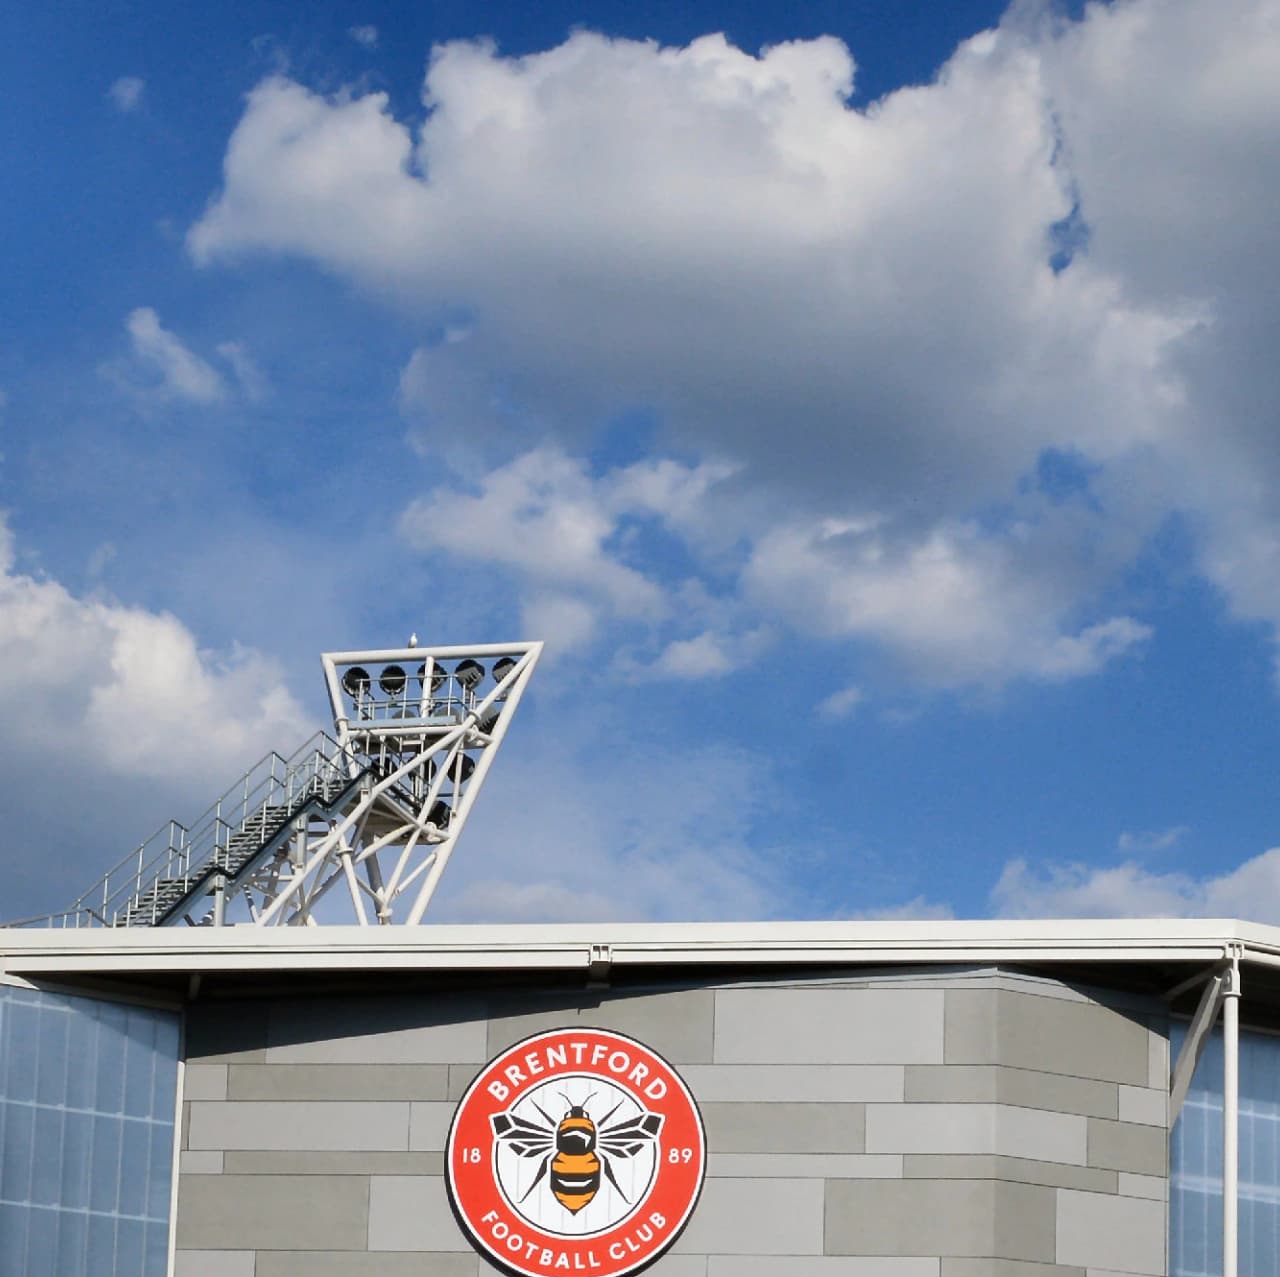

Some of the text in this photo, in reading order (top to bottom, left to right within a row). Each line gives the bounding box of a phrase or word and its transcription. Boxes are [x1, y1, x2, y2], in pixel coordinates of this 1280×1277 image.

[487, 1043, 667, 1101] BRENTFORD
[462, 1148, 481, 1164] 18
[669, 1148, 693, 1164] 89
[481, 1210, 666, 1269] FOOTBALL CLUB
